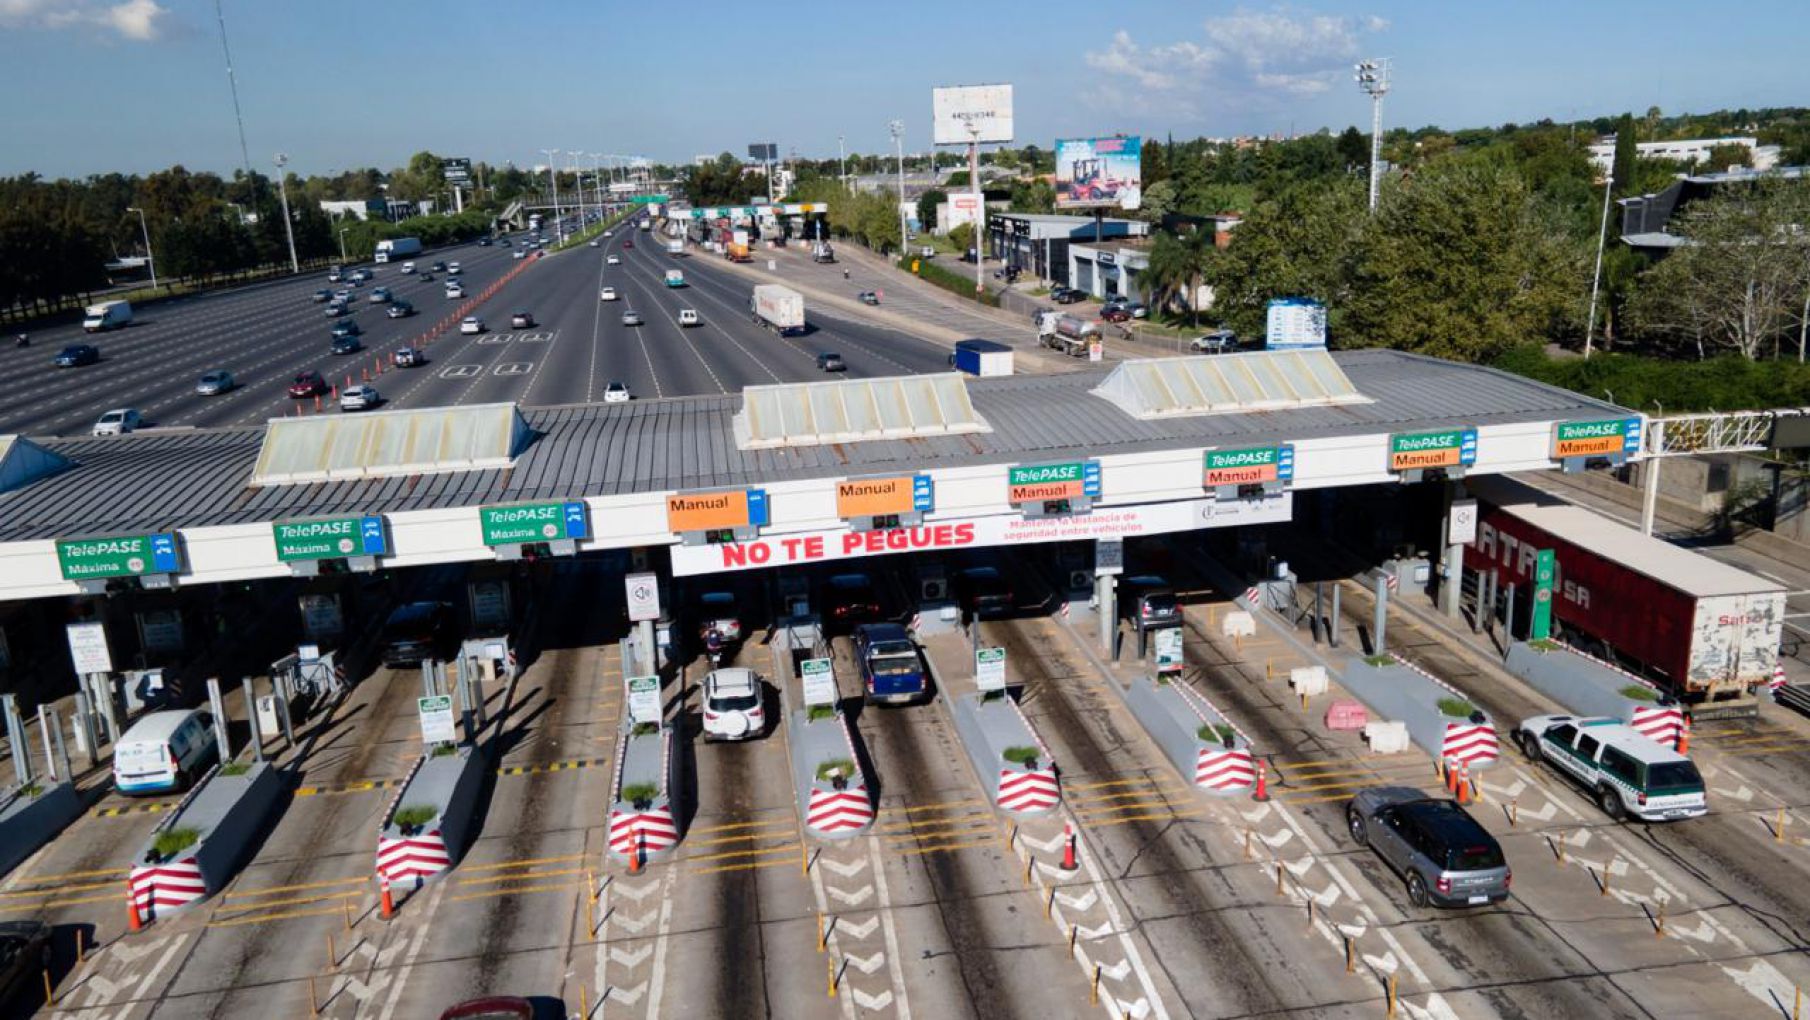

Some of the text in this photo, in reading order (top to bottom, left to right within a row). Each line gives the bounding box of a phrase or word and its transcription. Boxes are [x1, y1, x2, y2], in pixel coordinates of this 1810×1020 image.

[1563, 423, 1619, 438] TelePASE
[1399, 435, 1455, 449] TelePASE
[1560, 440, 1609, 453] Manual
[1211, 450, 1274, 467] TelePASE
[1396, 452, 1446, 465] Manual
[1015, 466, 1078, 482] TelePASE
[1209, 469, 1262, 483] Manual
[840, 482, 896, 497] Manual
[1013, 485, 1067, 499] Manual
[670, 496, 729, 511] Manual
[489, 506, 558, 523] TelePASE
[1074, 512, 1122, 524] distancia
[1123, 511, 1137, 521] de
[280, 521, 353, 538] TelePASE
[1004, 528, 1058, 541] seguridad
[1060, 526, 1089, 536] entre
[64, 539, 142, 558] TelePASE
[723, 523, 975, 568] NO TE PEGUES
[1564, 579, 1591, 610] SA
